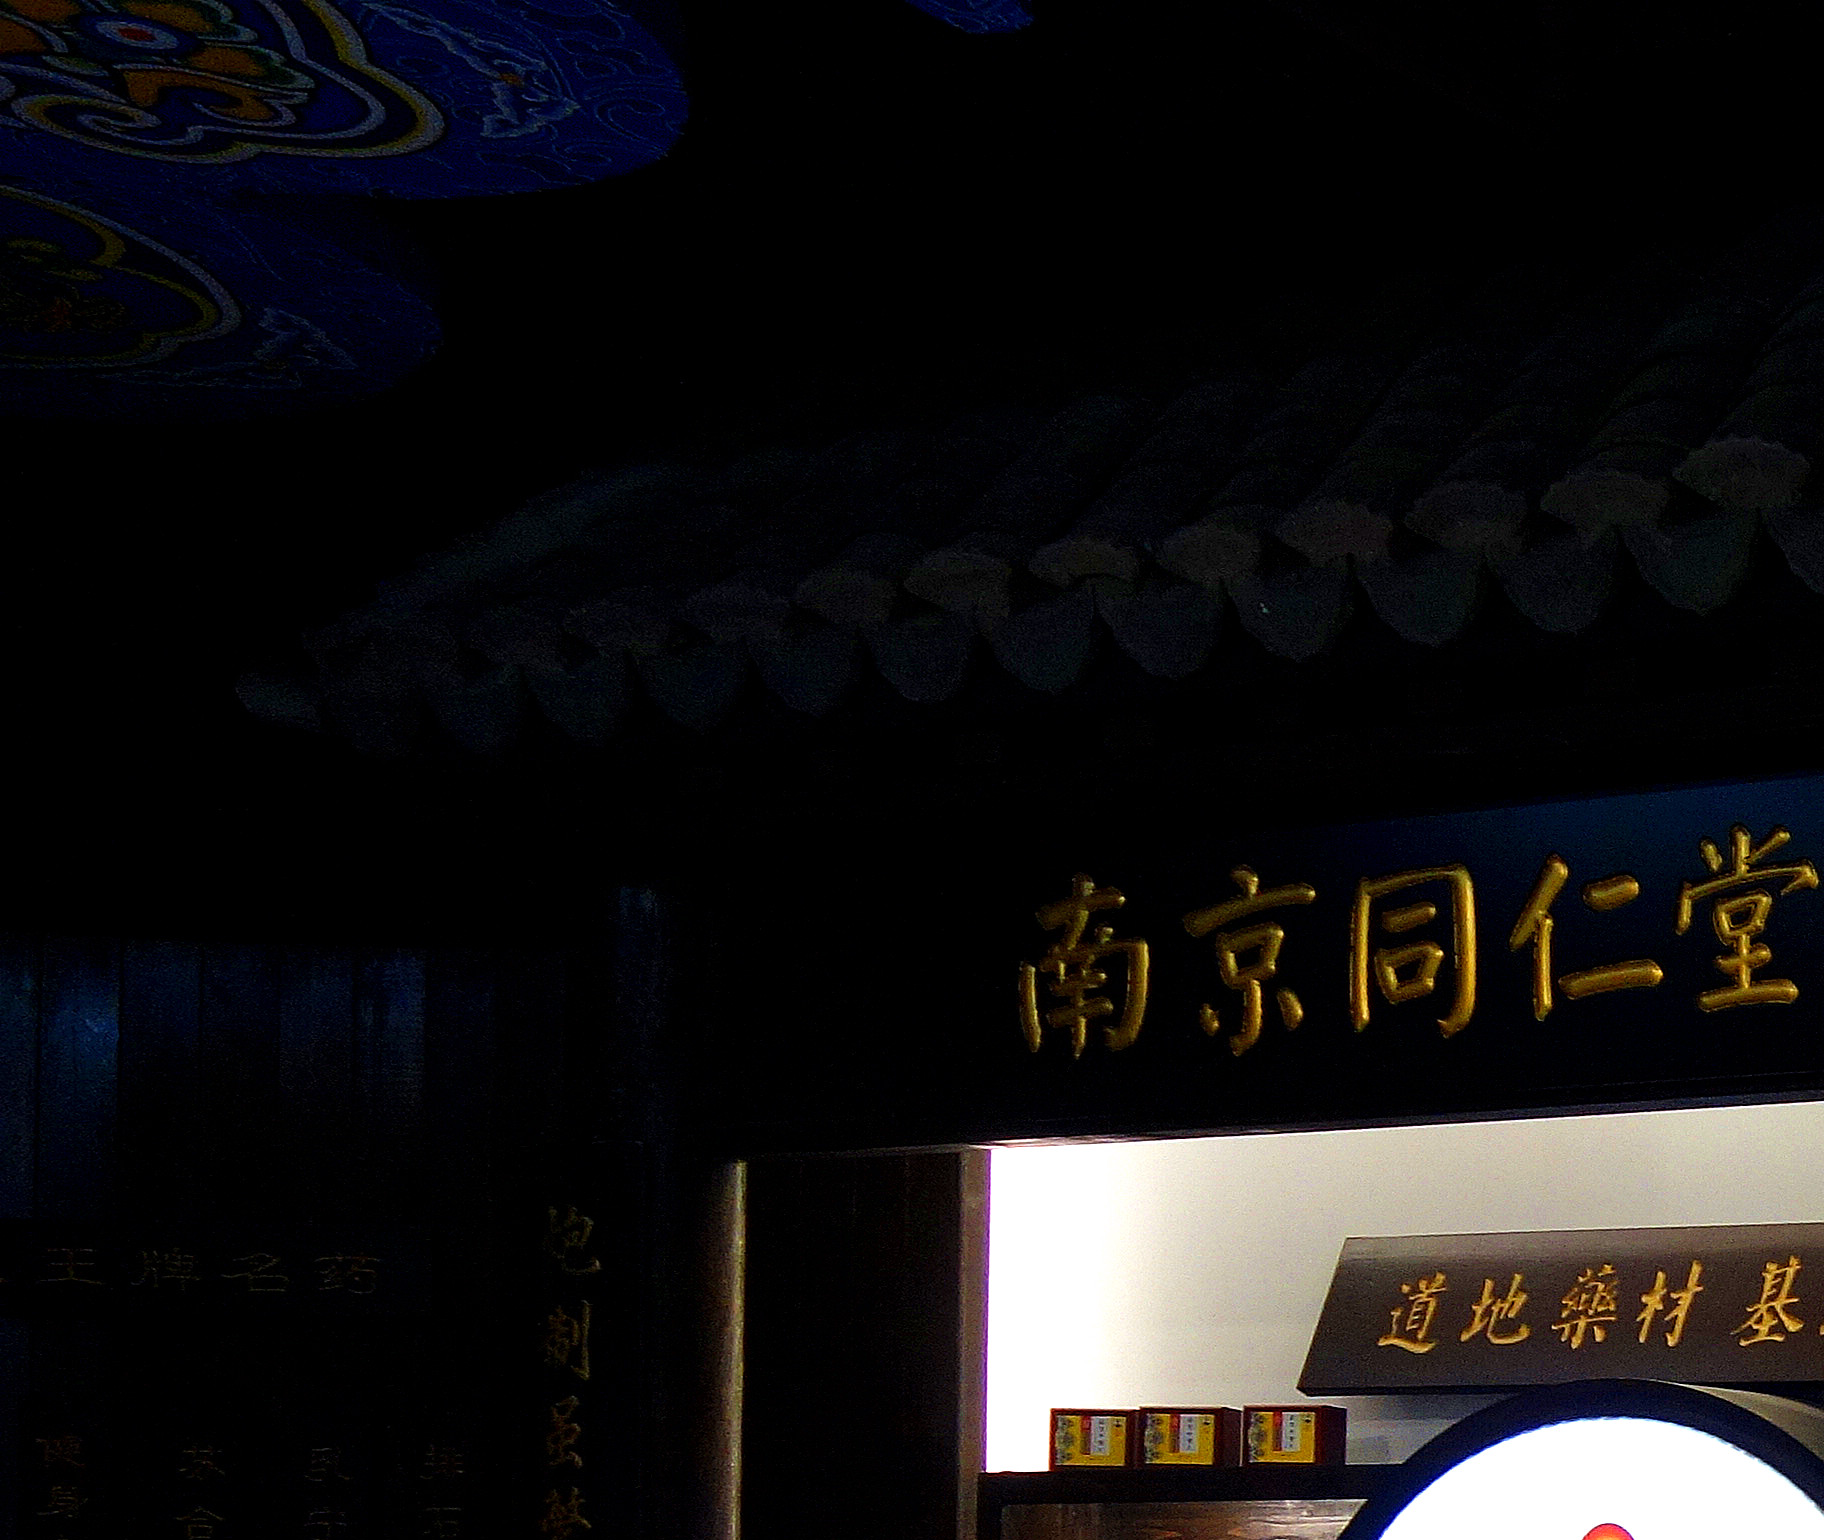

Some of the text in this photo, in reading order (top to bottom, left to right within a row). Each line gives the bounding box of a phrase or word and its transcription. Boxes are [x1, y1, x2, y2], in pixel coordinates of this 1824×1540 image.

[1017, 822, 1819, 1058] 南京同仁堂
